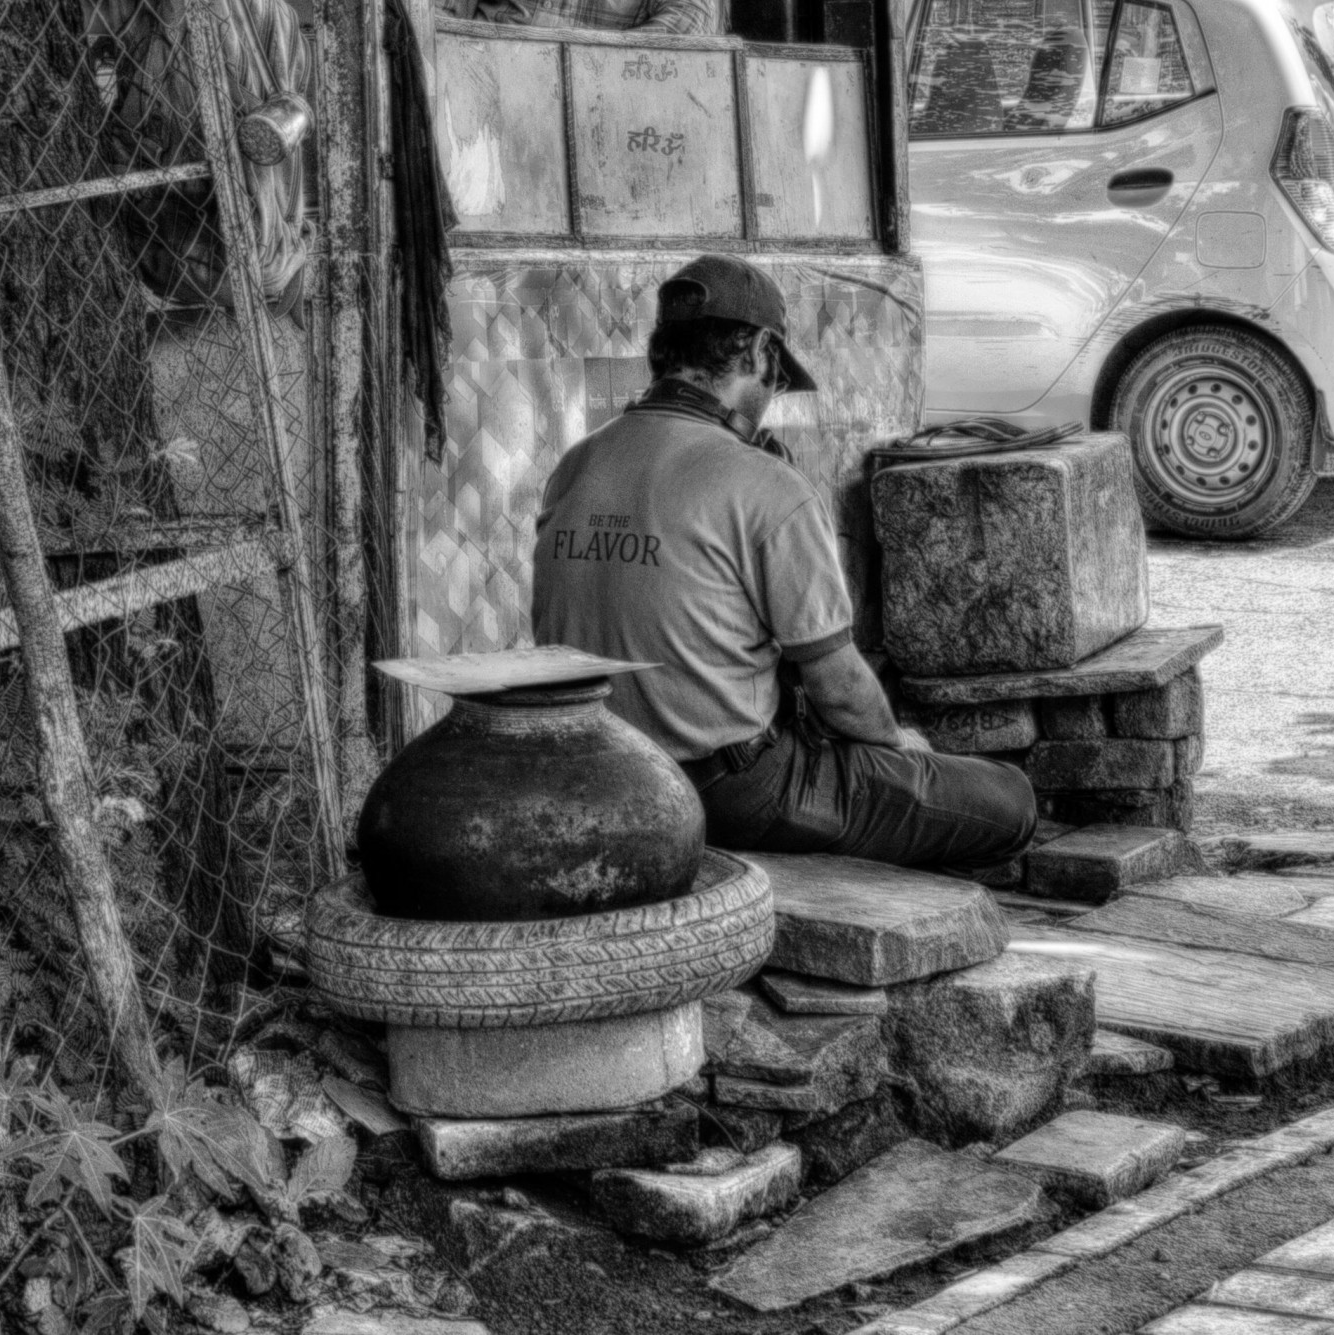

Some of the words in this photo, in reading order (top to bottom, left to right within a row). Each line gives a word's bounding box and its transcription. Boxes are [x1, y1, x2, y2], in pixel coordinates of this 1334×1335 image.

[589, 514, 605, 527] BE
[608, 514, 631, 528] THE
[553, 530, 660, 567] FLAVOR
